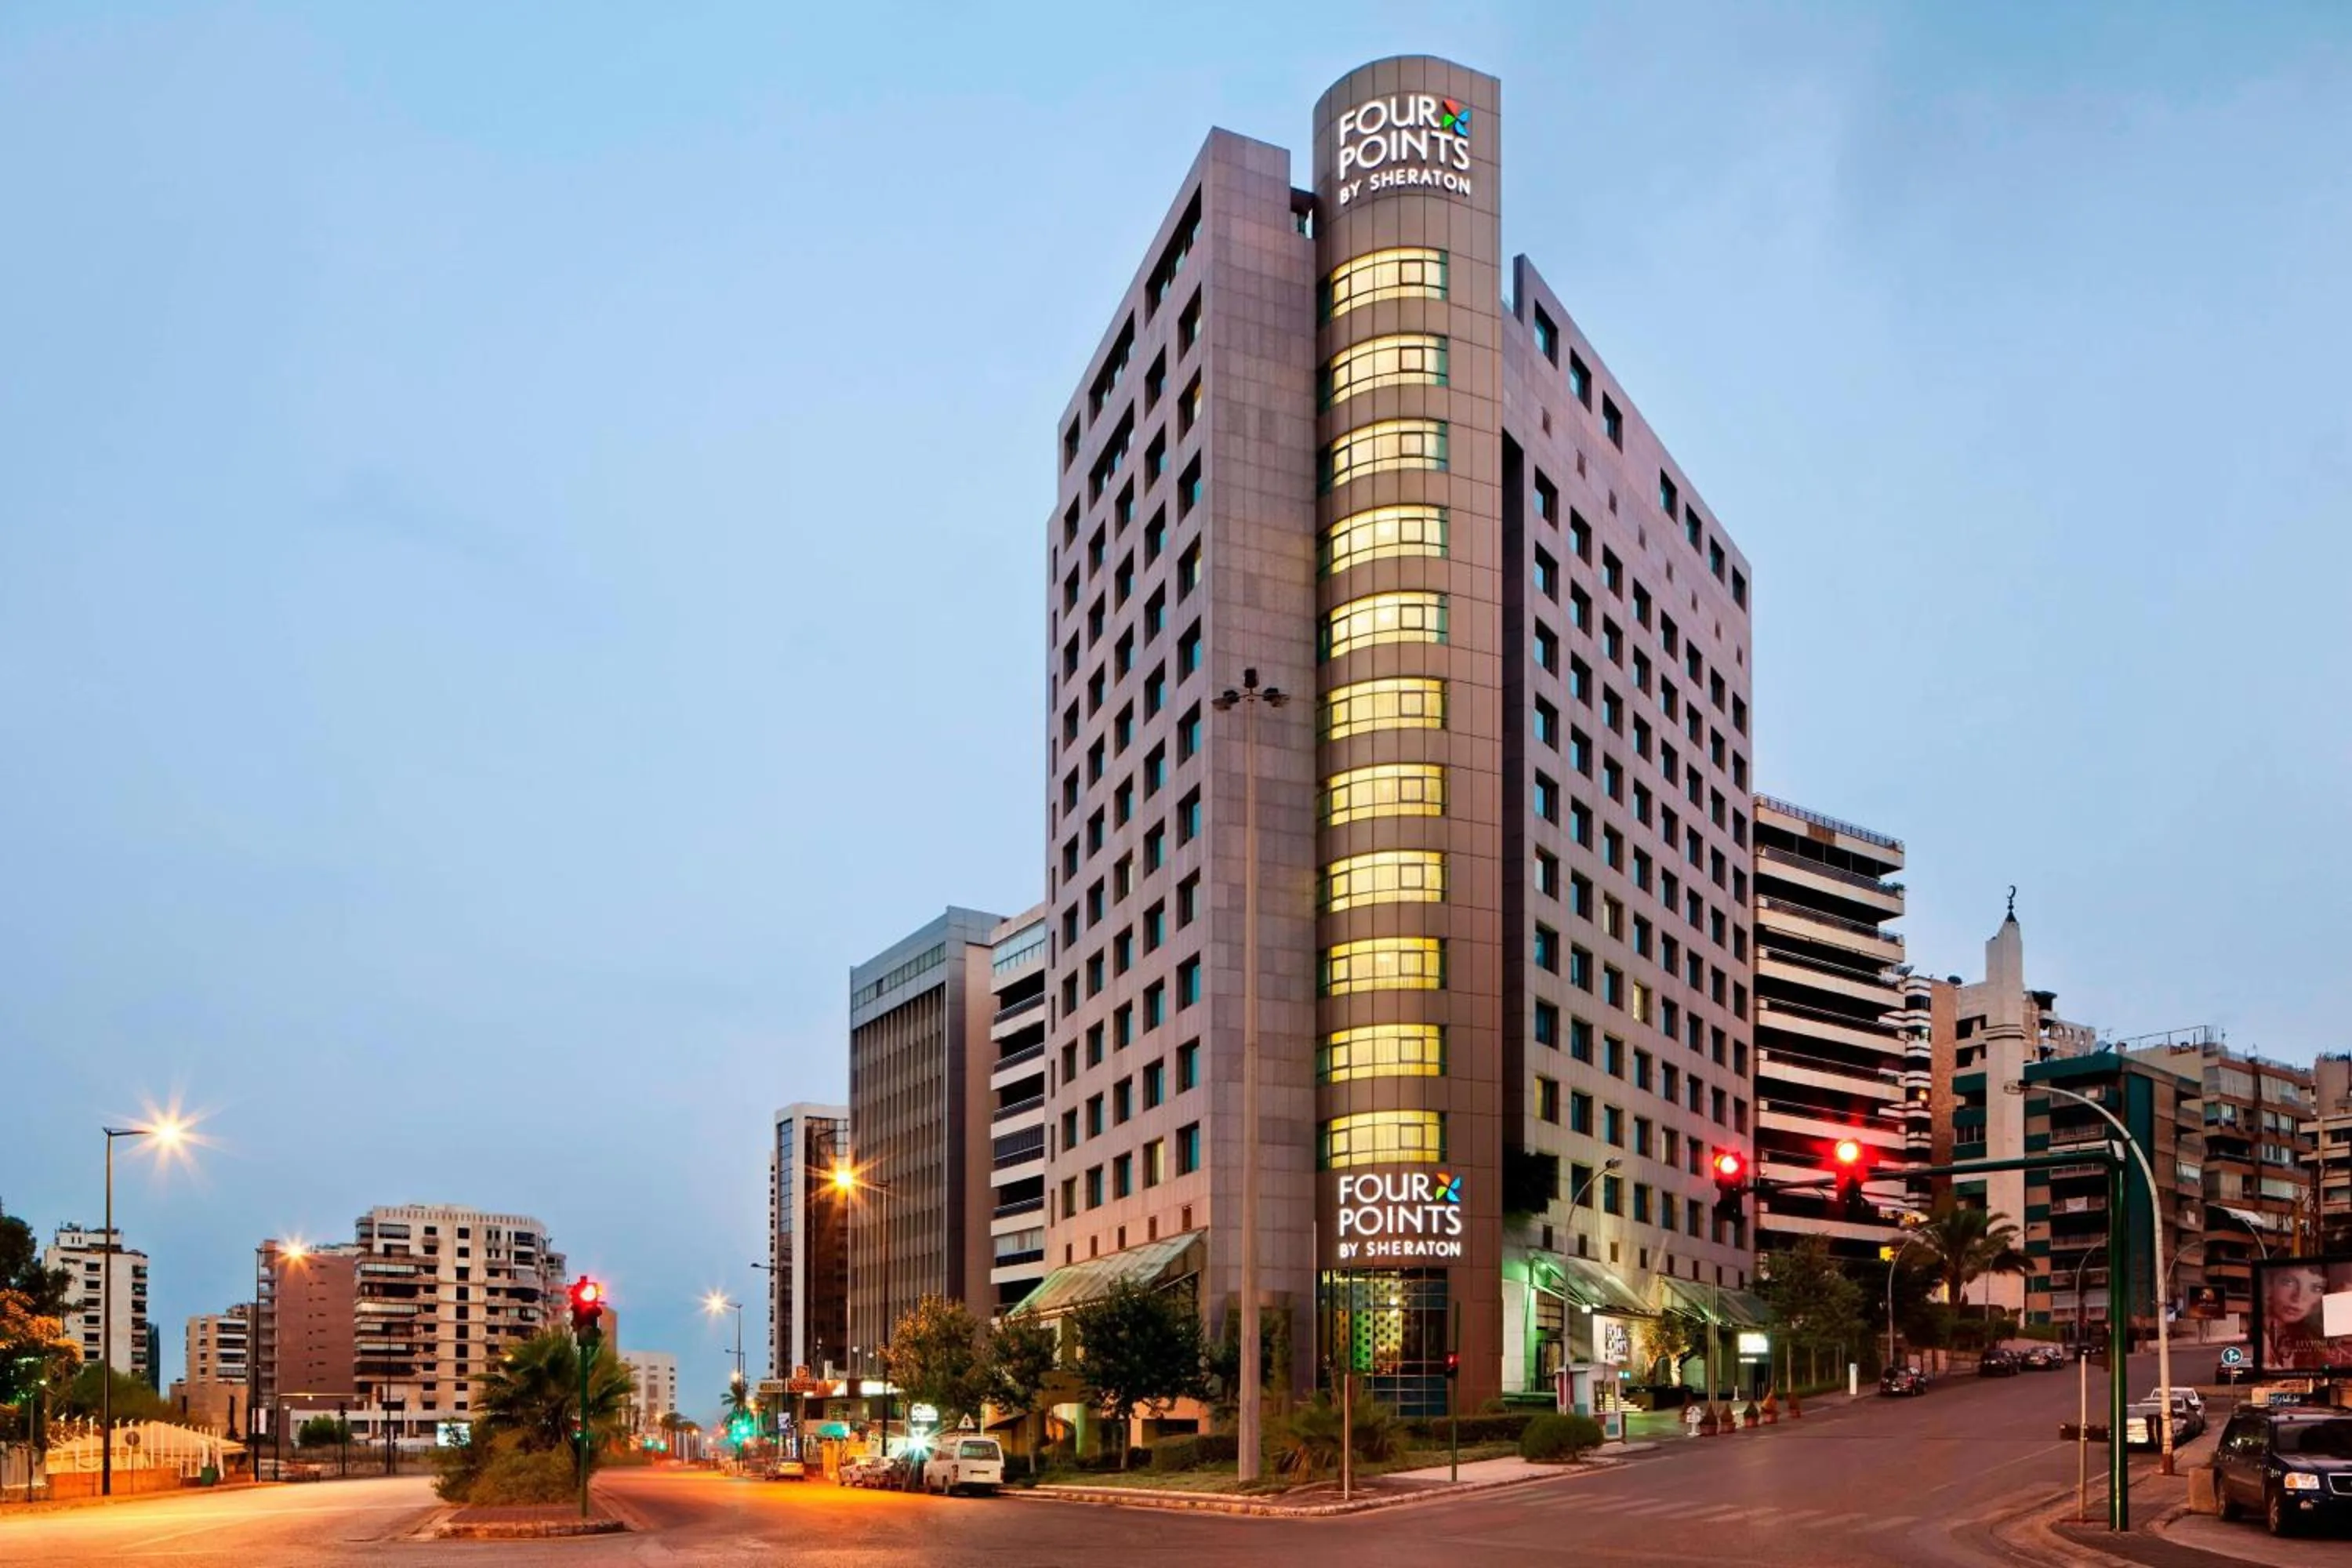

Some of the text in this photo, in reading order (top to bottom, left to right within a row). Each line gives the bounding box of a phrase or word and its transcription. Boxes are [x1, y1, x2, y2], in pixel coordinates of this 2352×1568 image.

[1339, 95, 1440, 147] FOUR
[1339, 129, 1470, 180] POINTS
[1339, 169, 1471, 204] BY SHERATON
[1339, 1173, 1433, 1204] FOUR
[1339, 1205, 1462, 1236] POINTS
[1339, 1241, 1461, 1258] BY SHERATON
